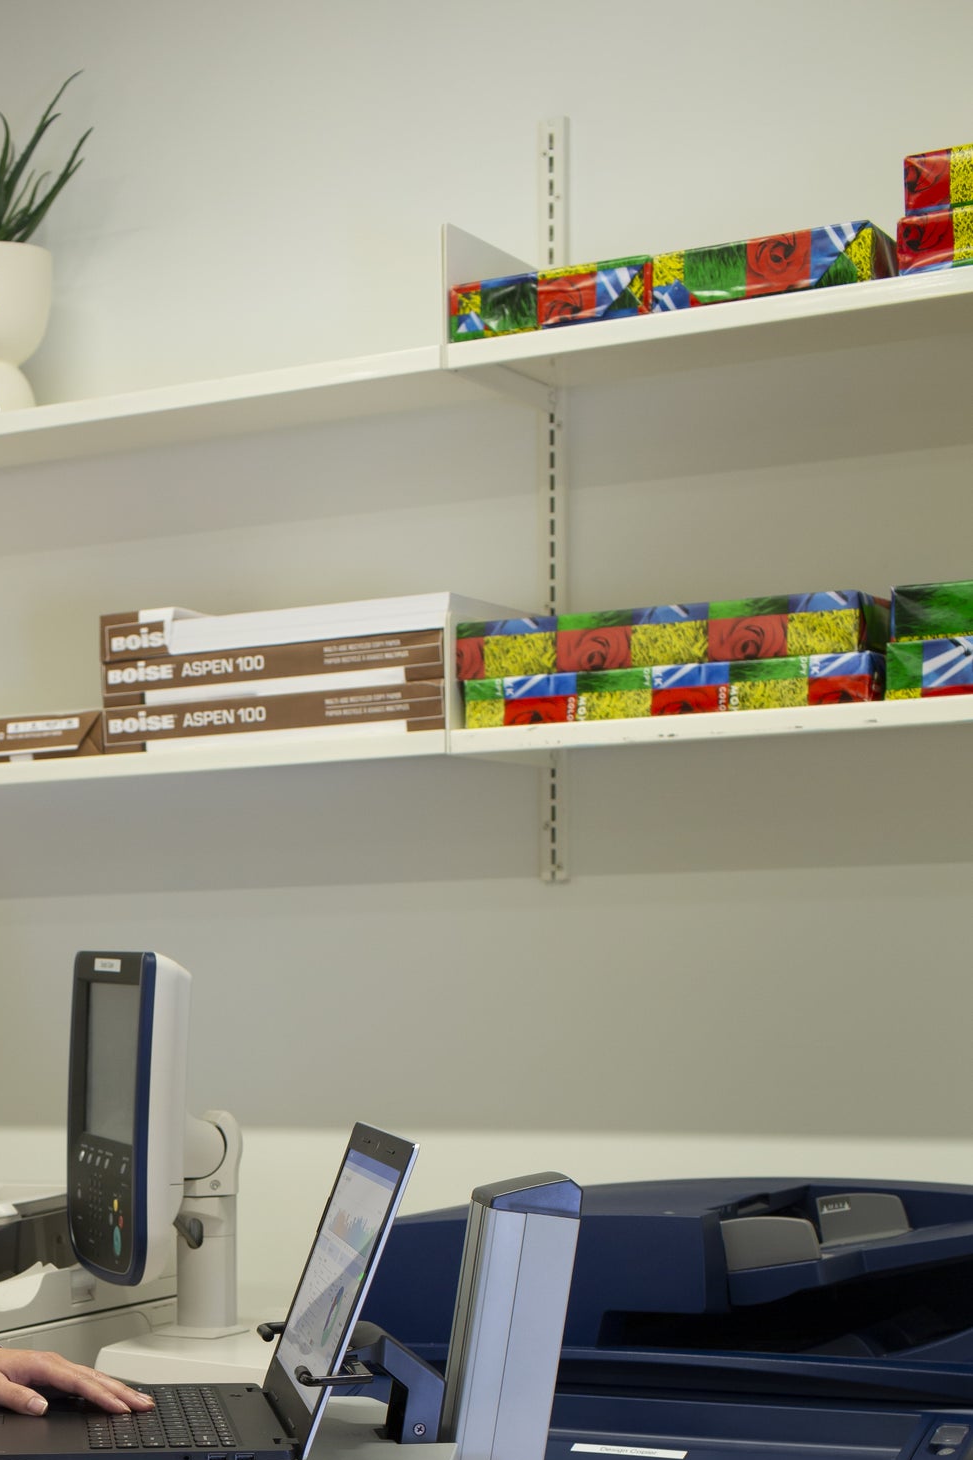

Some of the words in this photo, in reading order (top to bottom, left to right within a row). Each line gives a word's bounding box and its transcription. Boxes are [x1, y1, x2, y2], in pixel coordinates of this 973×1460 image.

[181, 658, 234, 678] ASPEN
[235, 655, 265, 672] 100
[182, 708, 235, 728] ASPEN
[236, 706, 266, 723] 100
